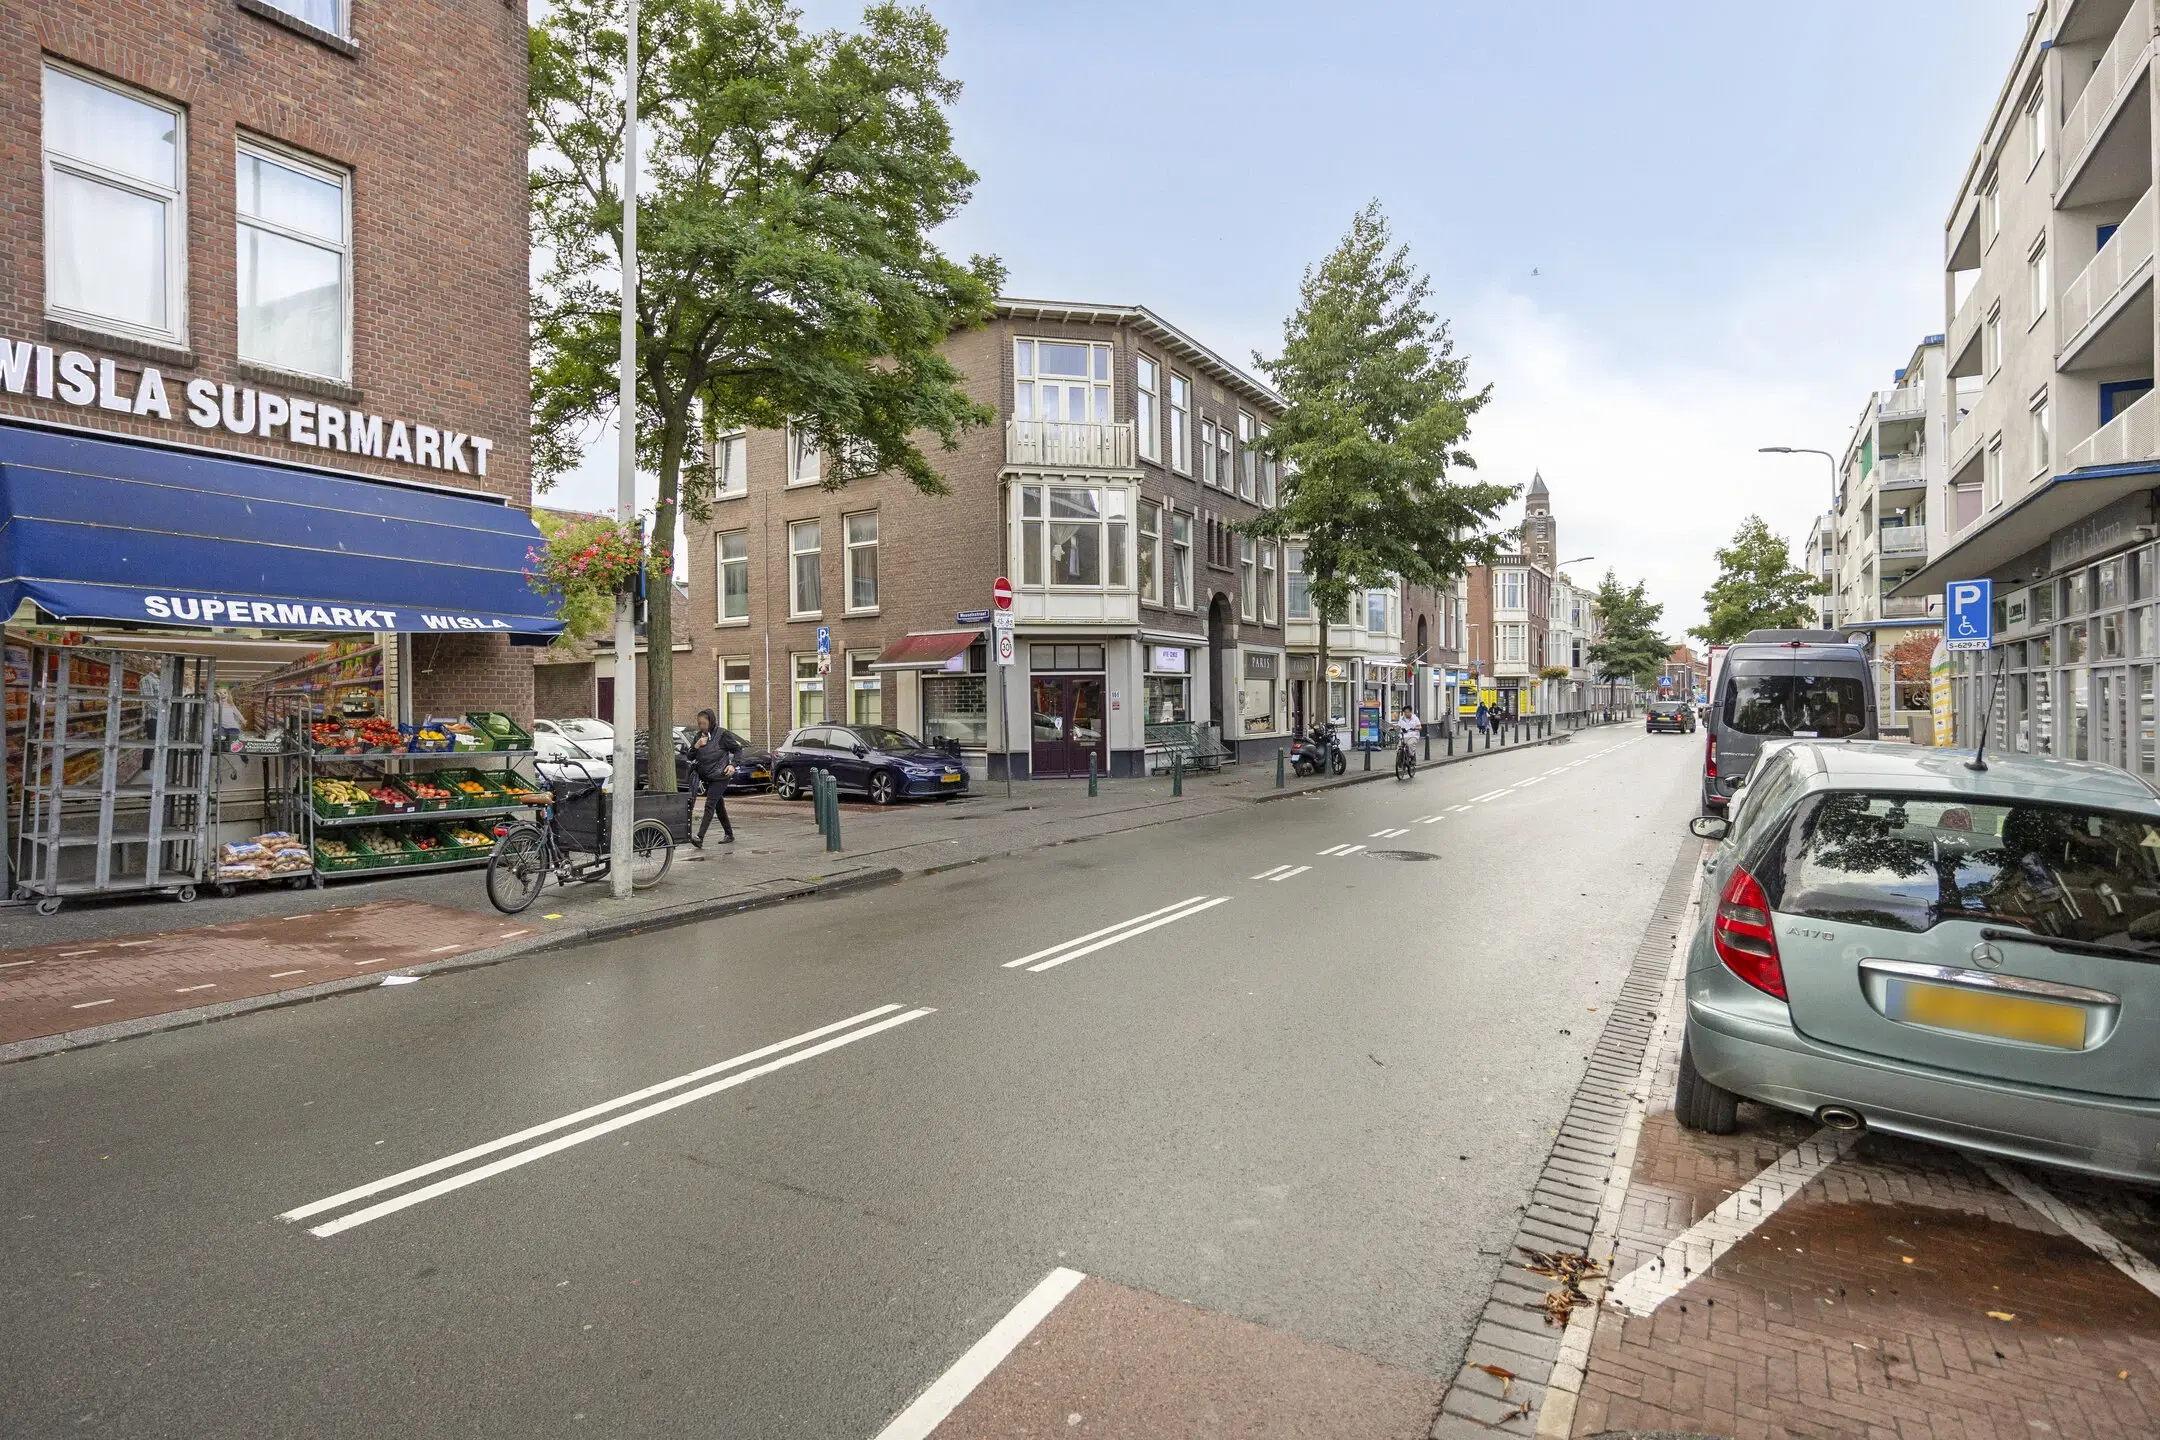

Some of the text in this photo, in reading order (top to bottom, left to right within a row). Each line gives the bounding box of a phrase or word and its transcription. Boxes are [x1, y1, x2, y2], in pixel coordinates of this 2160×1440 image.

[0, 339, 493, 477] WISLA SUPERMARKT
[1955, 585, 1981, 615] P
[146, 595, 512, 629] SUPERMARKT WISLA
[1001, 643, 1010, 651] 30
[1948, 641, 1988, 649] S-629-FX
[1252, 657, 1270, 668] PARIS
[1293, 660, 1308, 671] PARIS
[1783, 926, 1835, 942] A170
